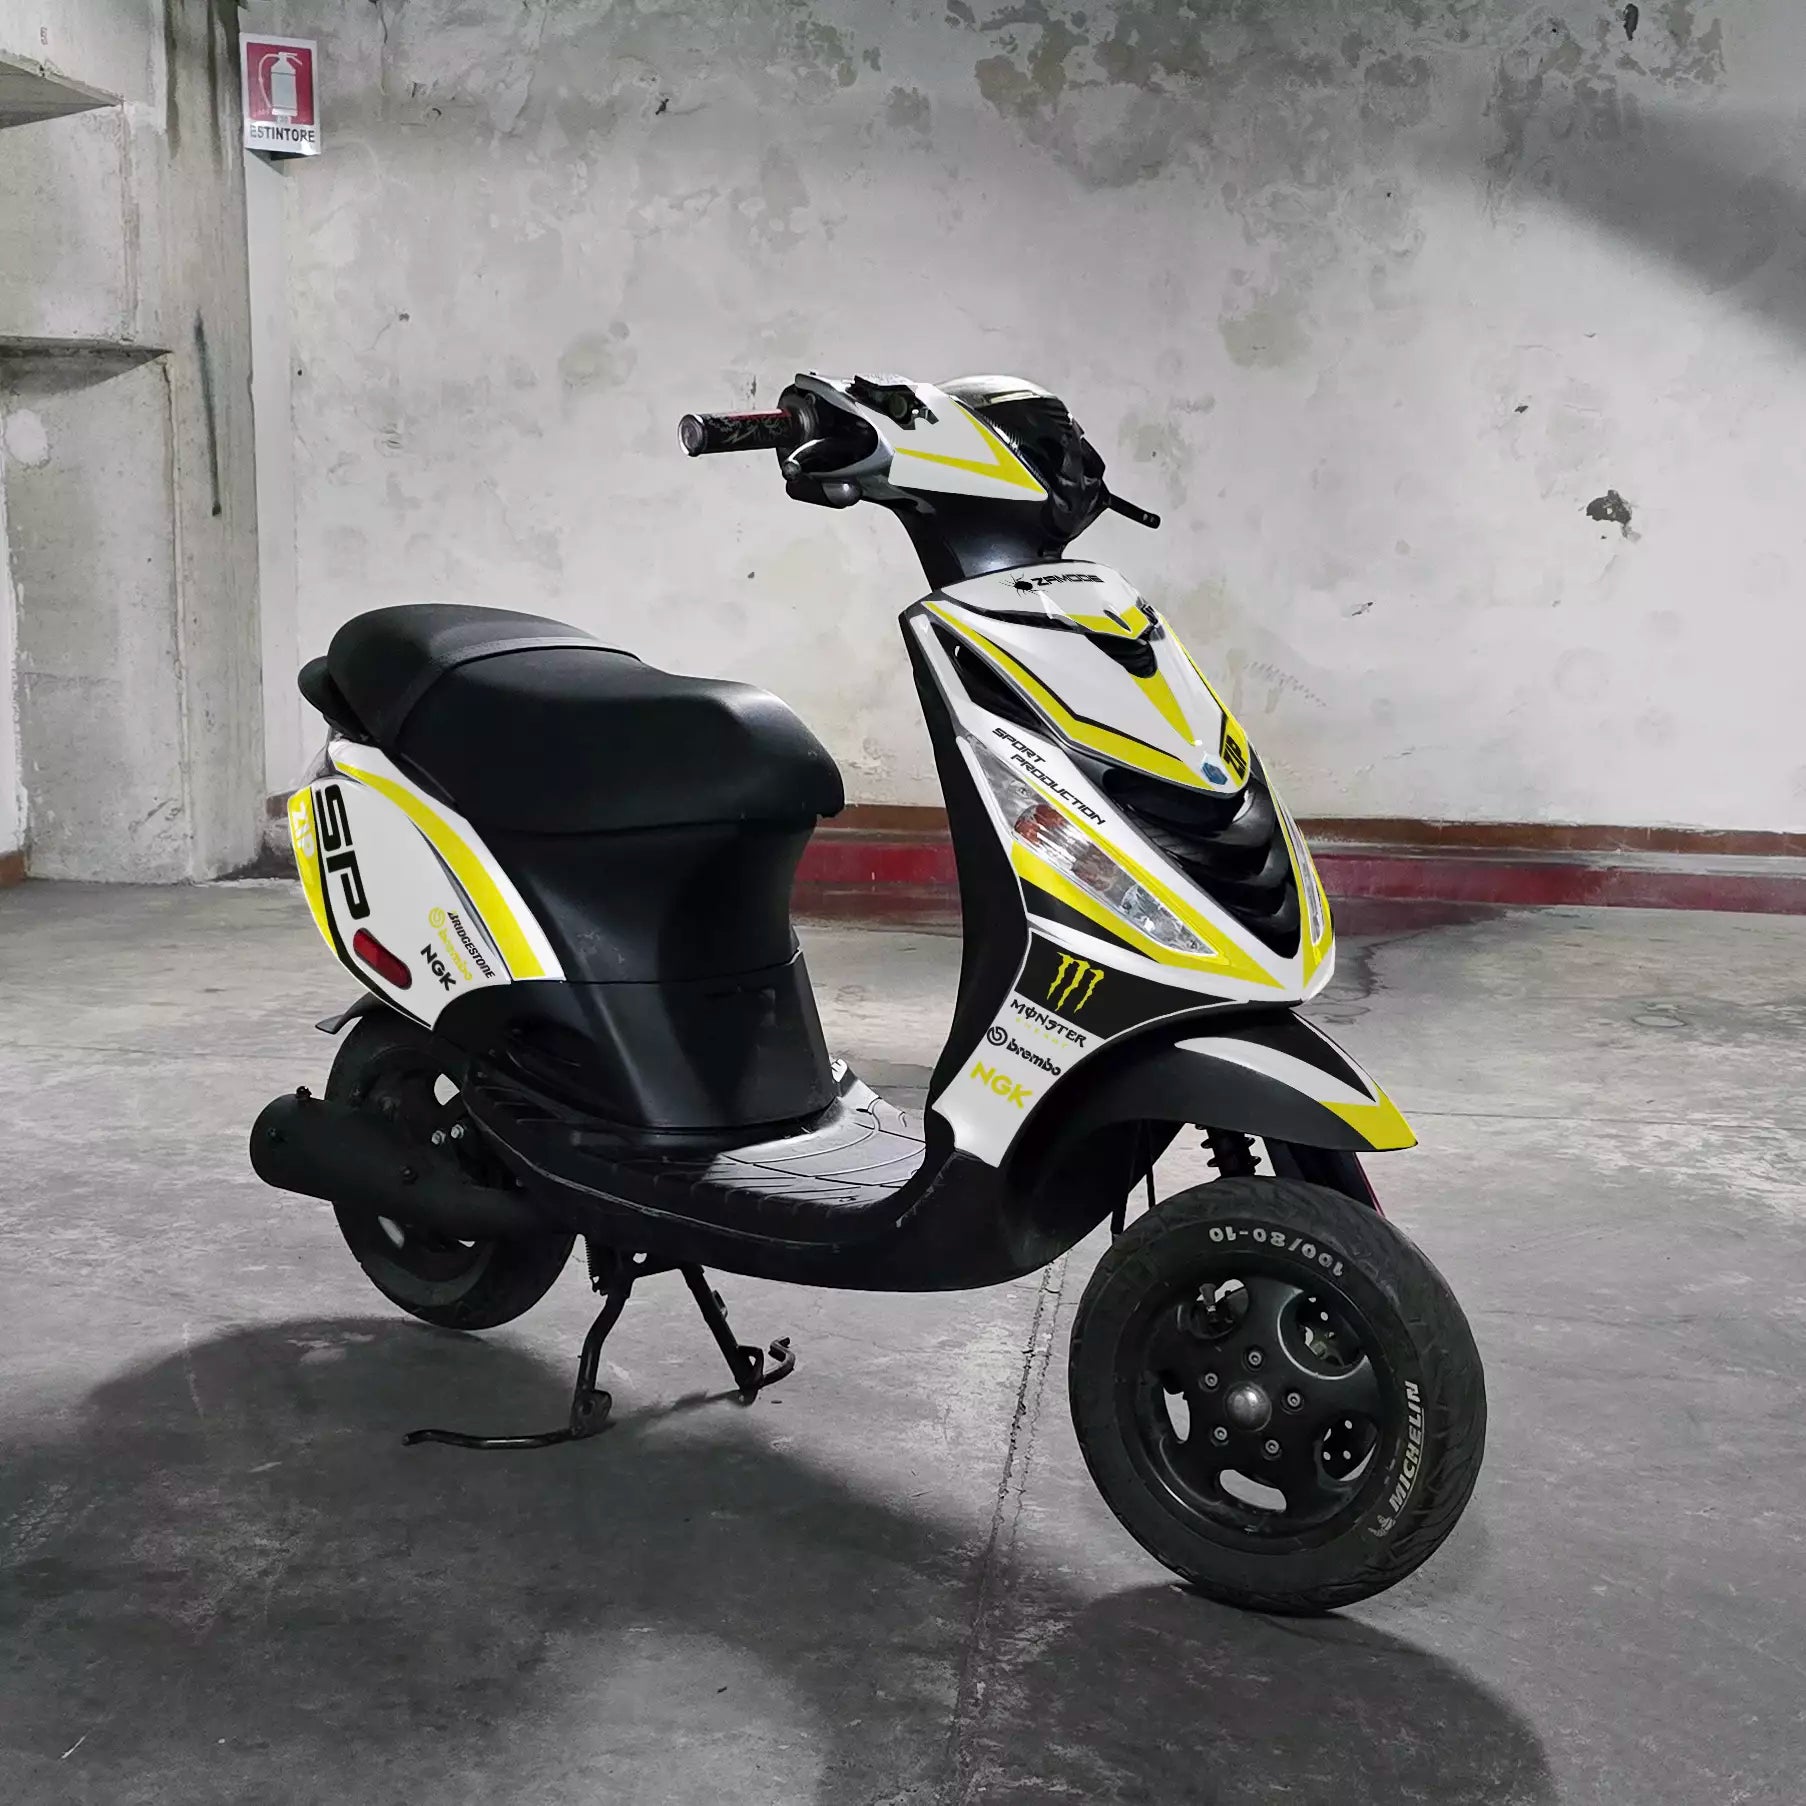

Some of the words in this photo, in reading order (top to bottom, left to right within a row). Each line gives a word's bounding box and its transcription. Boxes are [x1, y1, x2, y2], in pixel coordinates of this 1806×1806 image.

[250, 125, 316, 143] ESTINTORE
[1031, 573, 1105, 587] ZAMODE
[992, 727, 1046, 763] SPORT
[1010, 753, 1106, 825] PRODUCTION
[315, 784, 370, 920] SP
[420, 943, 457, 991] NGK
[447, 910, 496, 979] BRIDGESTONE
[1006, 1038, 1061, 1076] brembo
[970, 1061, 1033, 1109] NGK
[1389, 1380, 1422, 1512] MICHELIN
